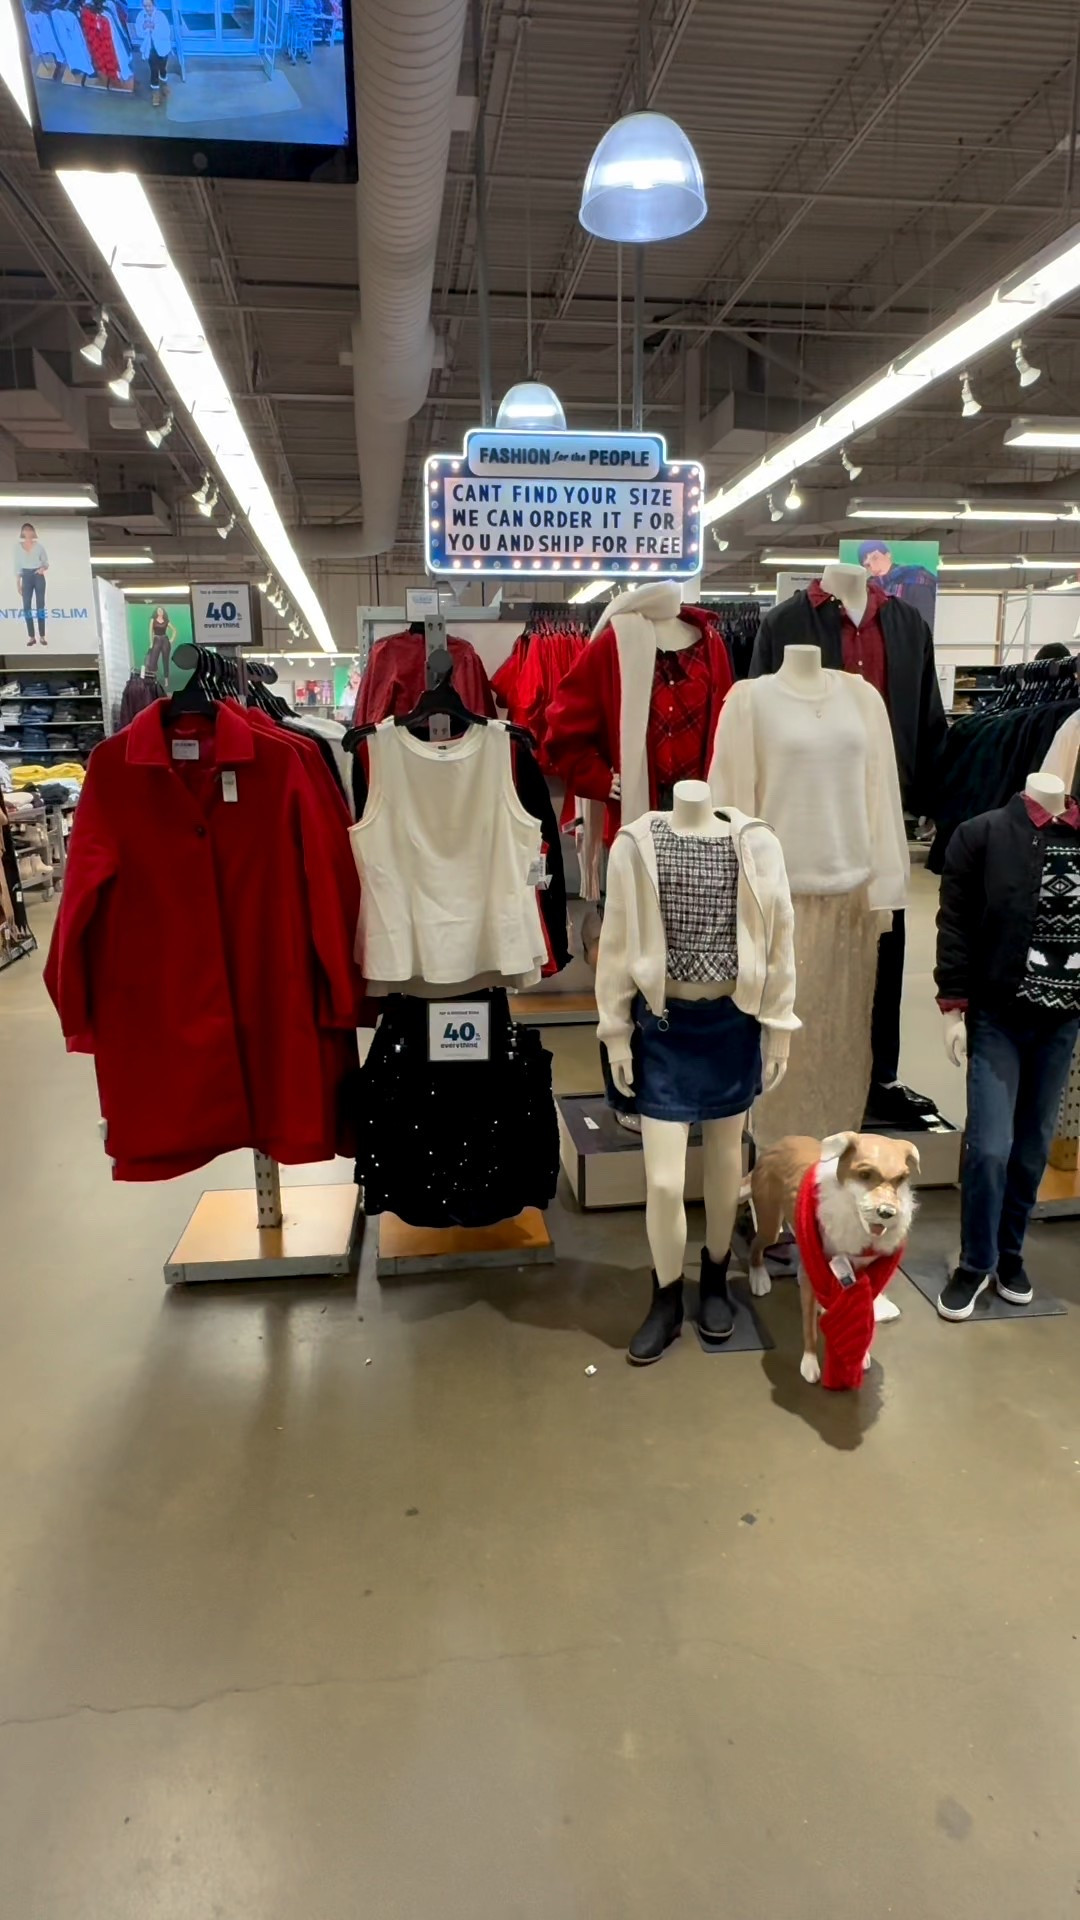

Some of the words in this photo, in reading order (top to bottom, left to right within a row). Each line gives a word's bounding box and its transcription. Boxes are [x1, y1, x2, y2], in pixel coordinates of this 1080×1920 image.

[479, 447, 550, 465] FASHION
[552, 451, 569, 462] for
[571, 452, 586, 462] the
[589, 449, 650, 466] PEOPLE
[452, 484, 502, 502] CANT
[513, 485, 557, 504] FIND
[564, 486, 617, 505] YOUR
[630, 488, 672, 507] SIZE
[452, 508, 478, 526] WE
[487, 509, 523, 527] CAN
[530, 510, 592, 528] ORDER
[603, 512, 621, 529] IT
[448, 533, 490, 551] YOU
[592, 536, 627, 553] FOR
[636, 536, 680, 554] FREE
[51, 608, 88, 618] SLIM
